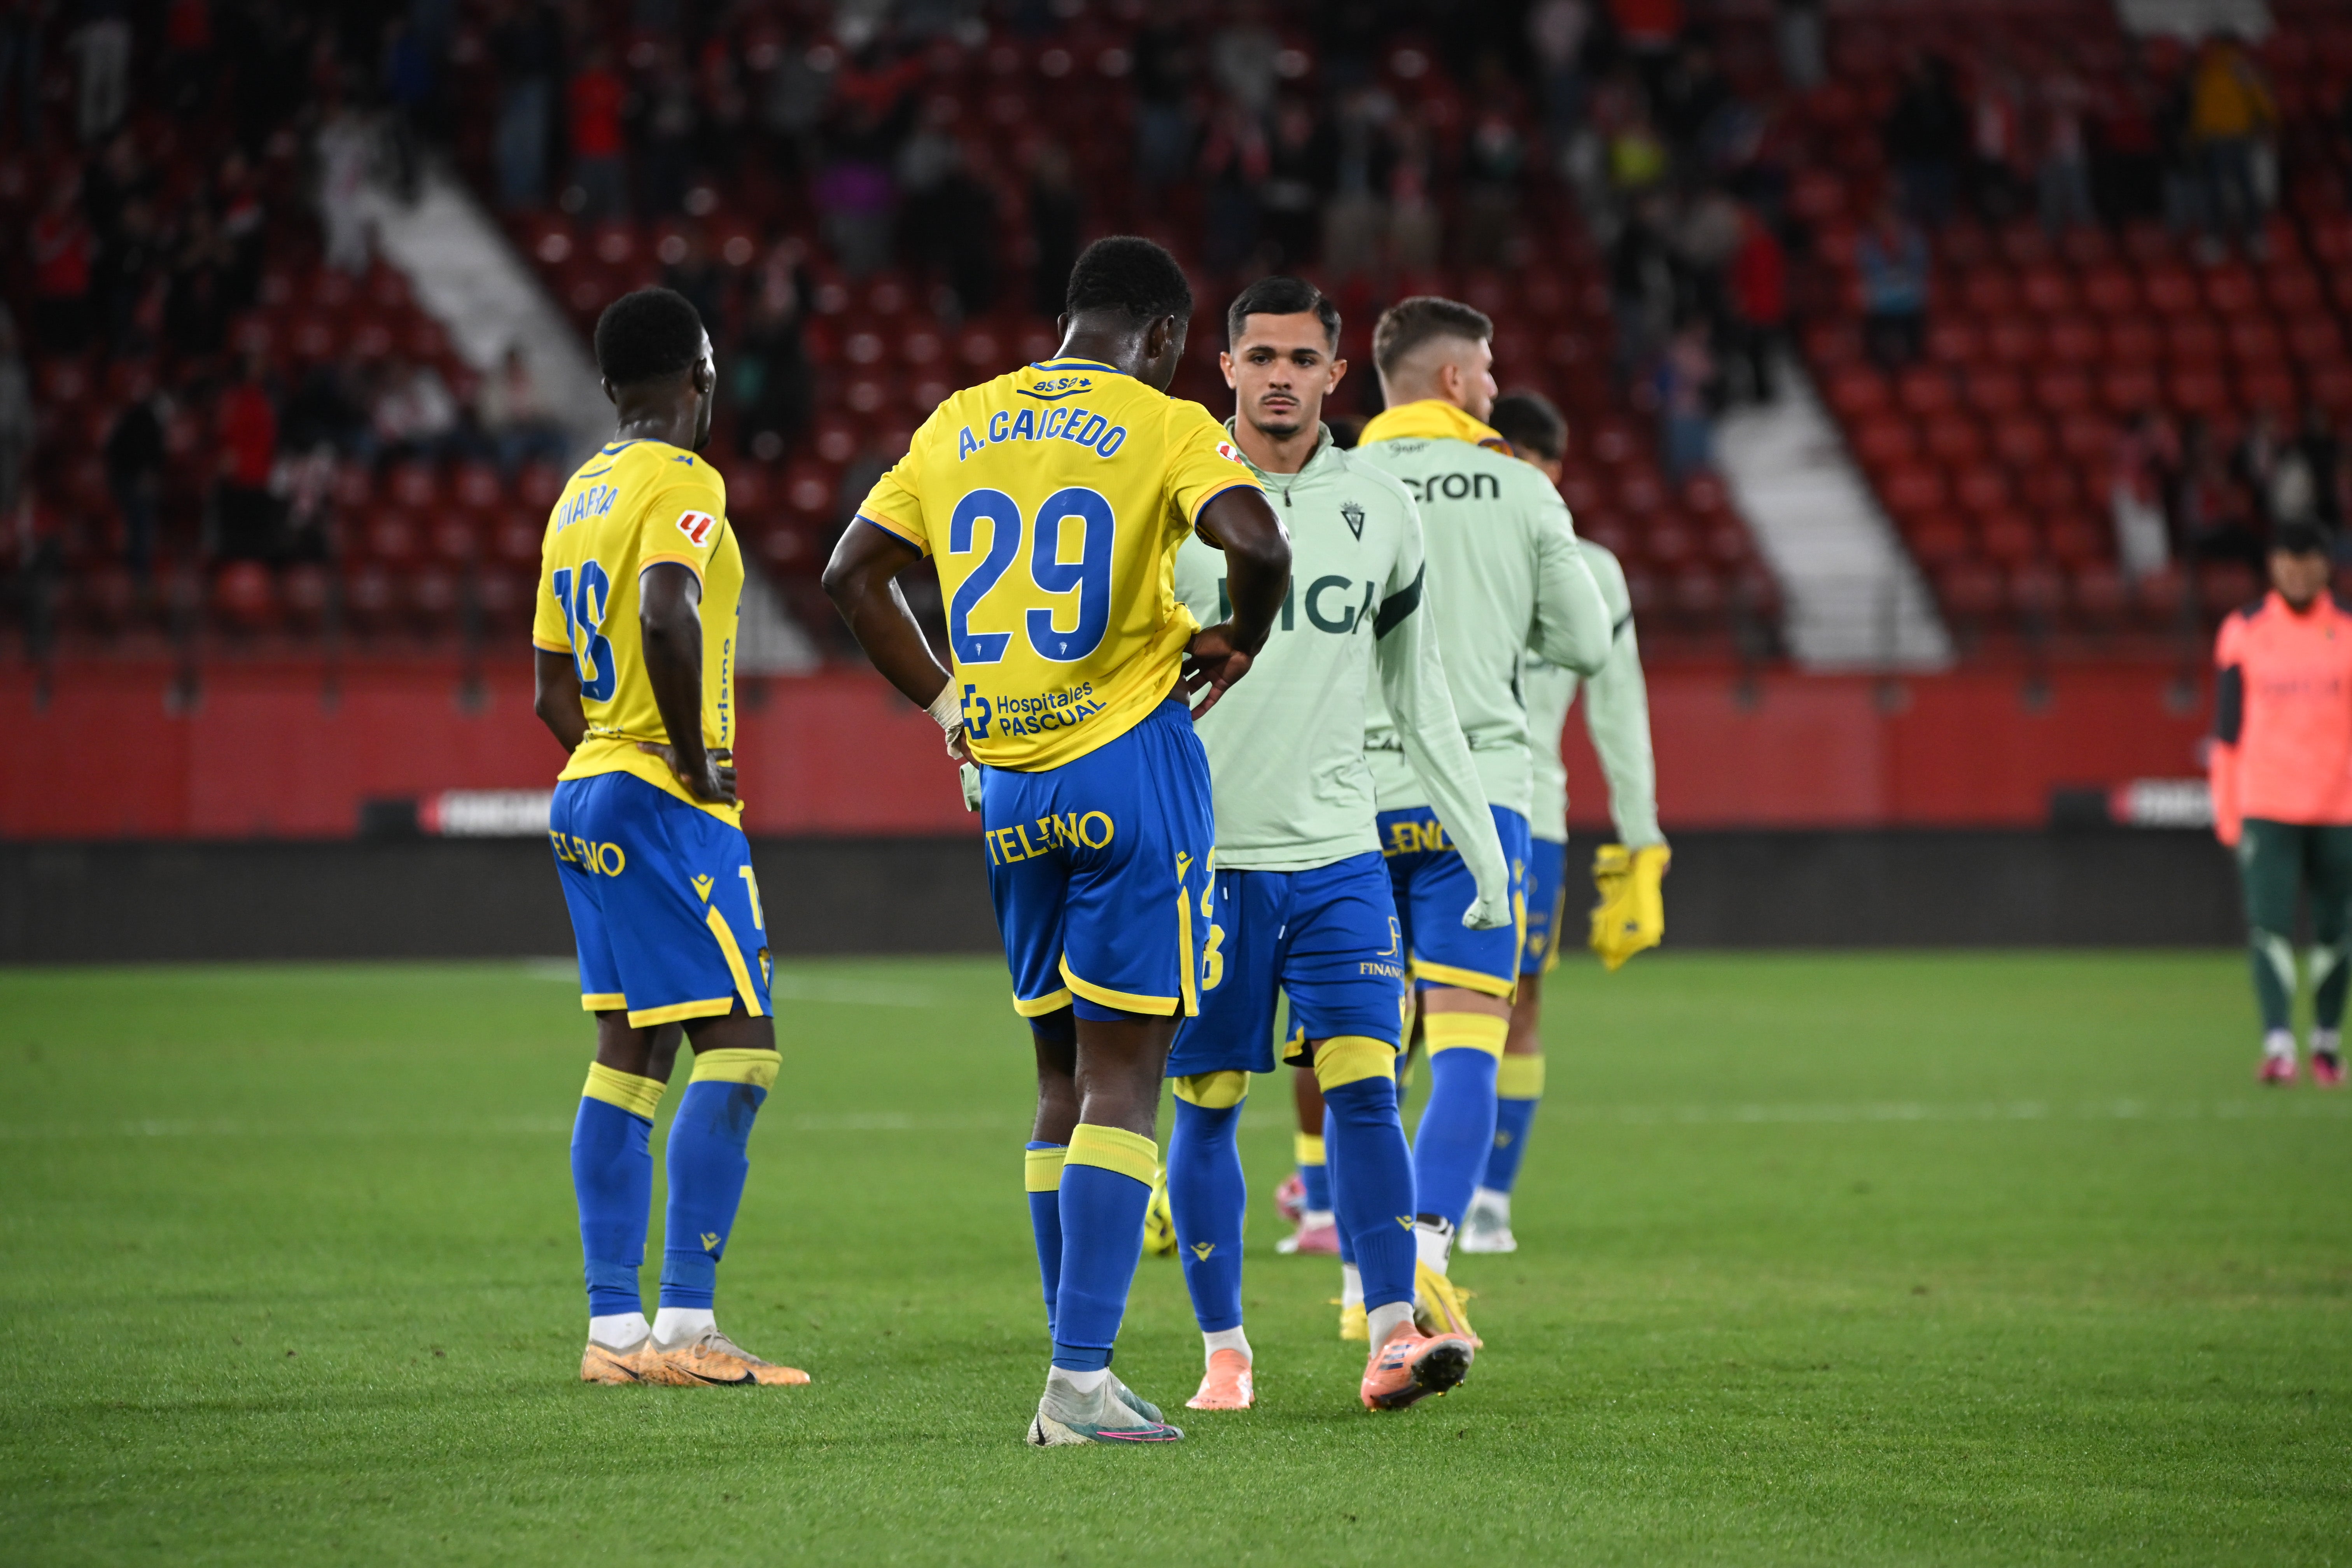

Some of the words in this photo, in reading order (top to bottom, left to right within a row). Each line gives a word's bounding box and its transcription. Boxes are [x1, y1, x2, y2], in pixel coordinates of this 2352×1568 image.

[949, 486, 1116, 665] 29
[553, 559, 617, 703] 18
[1218, 574, 1375, 635] IGI
[996, 681, 1093, 716] Hospitales
[999, 699, 1108, 737] PASCUAL
[549, 829, 626, 877] ELENO
[985, 810, 1115, 866] TELENO
